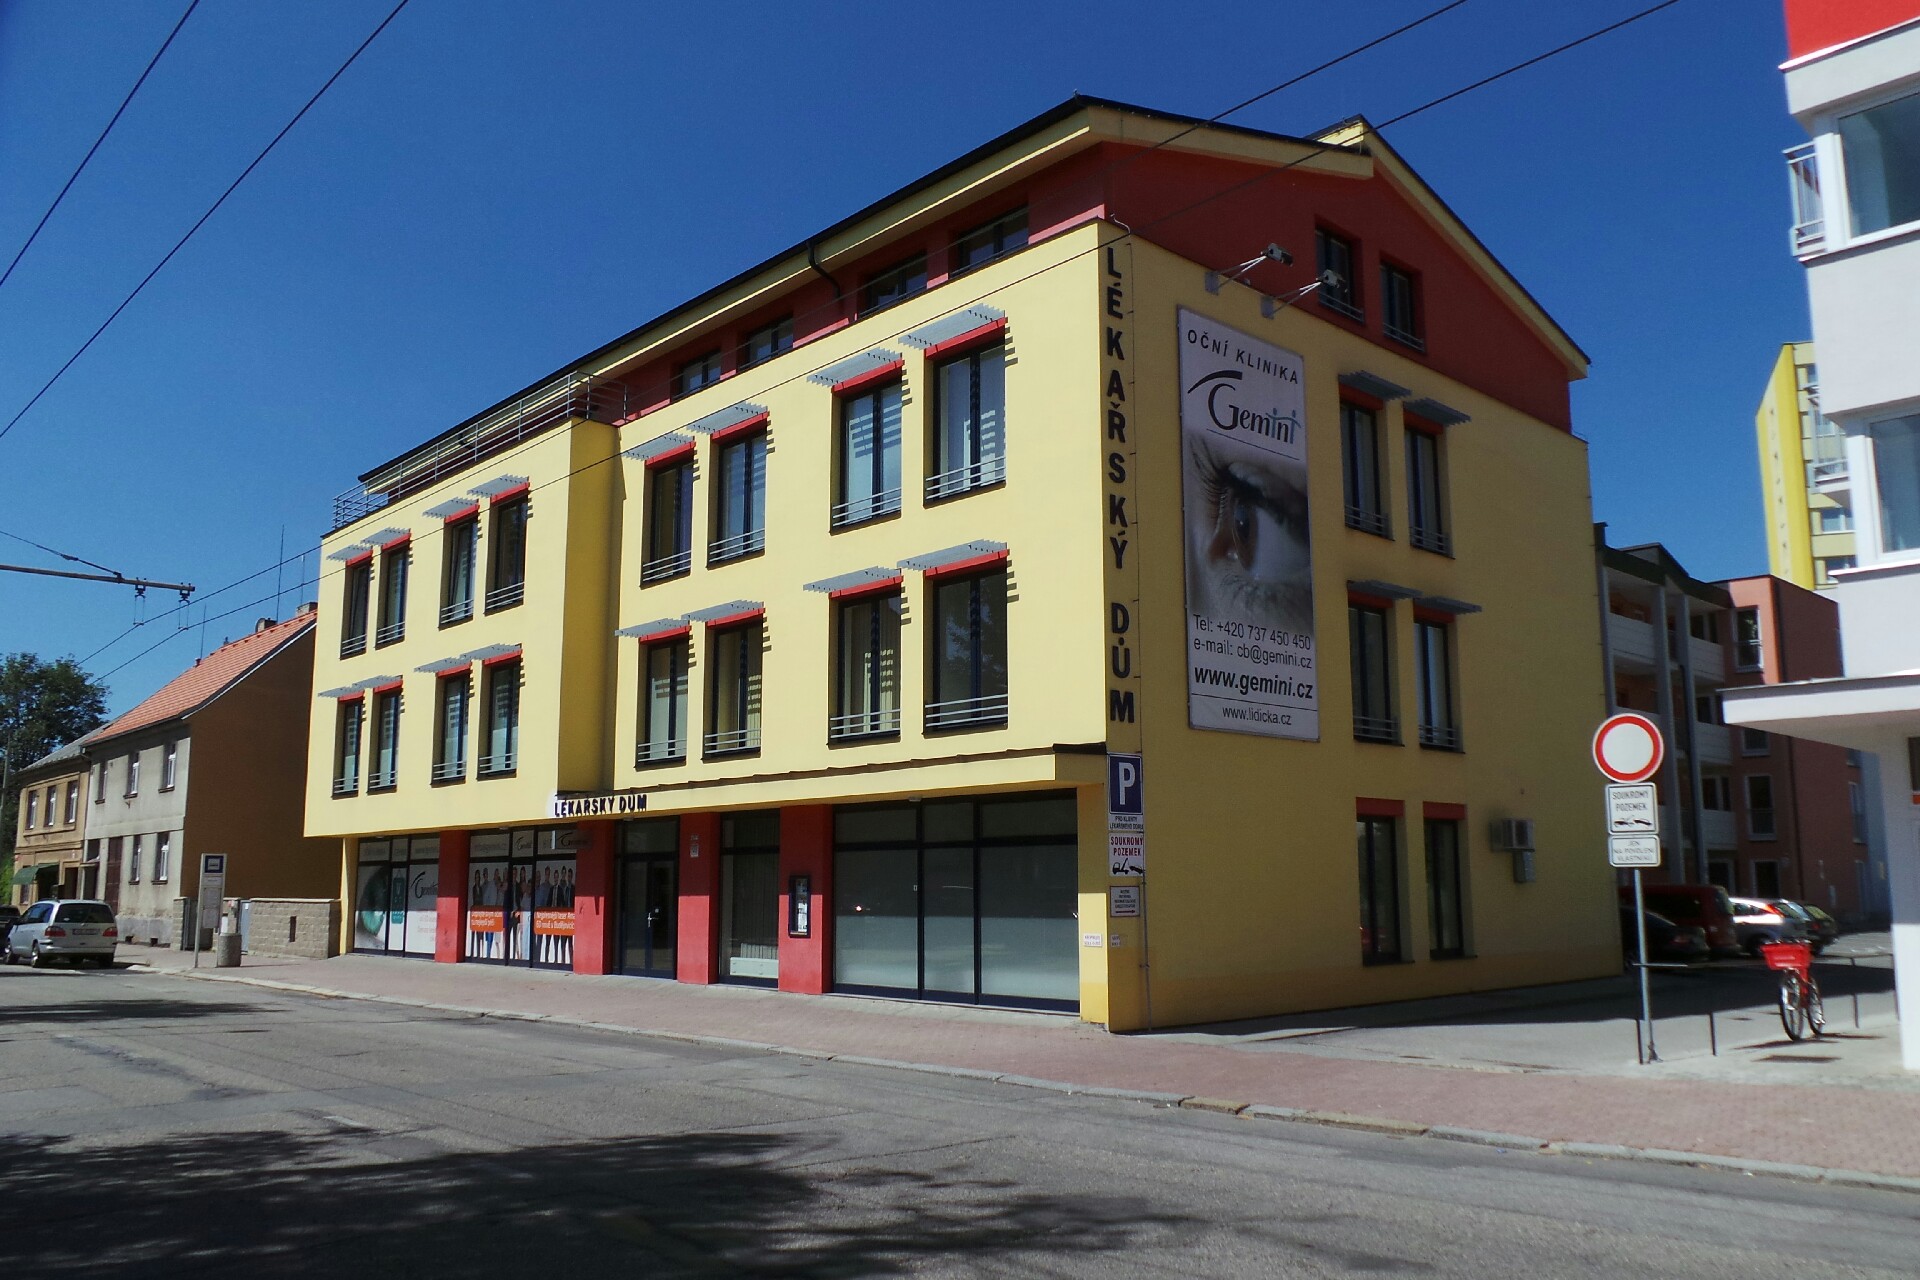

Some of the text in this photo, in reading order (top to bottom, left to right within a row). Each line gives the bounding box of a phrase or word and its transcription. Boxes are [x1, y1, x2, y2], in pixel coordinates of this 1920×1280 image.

[1187, 329, 1298, 384] OČNÍ KLINIKA
[1207, 382, 1302, 445] Gemini
[1105, 247, 1135, 724] LÉKAŘSKÝ DŮM
[1193, 614, 1311, 651] Tel: +420 737 450 450
[1193, 637, 1312, 669] e-mail: cb@gemini.cz
[1194, 667, 1314, 700] www.gemini.cz
[1222, 706, 1292, 726] www.lidicka.cz
[1118, 761, 1136, 806] P
[1113, 847, 1142, 857] POZEMEK
